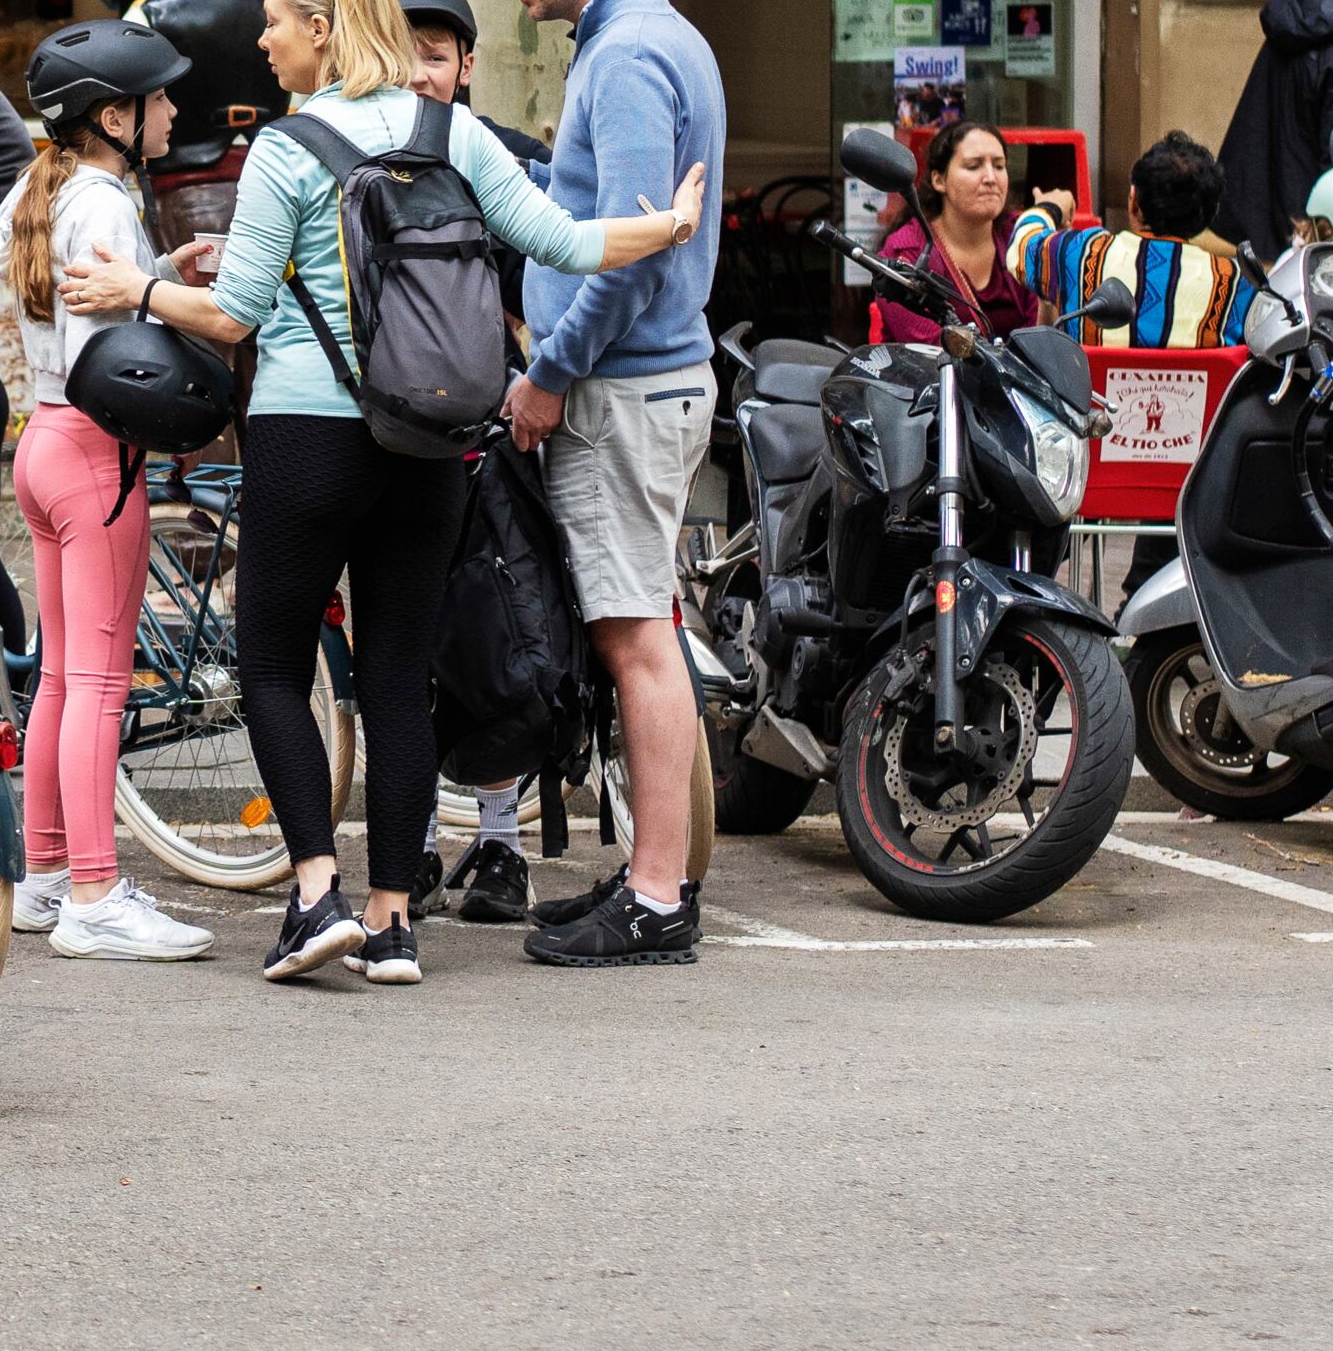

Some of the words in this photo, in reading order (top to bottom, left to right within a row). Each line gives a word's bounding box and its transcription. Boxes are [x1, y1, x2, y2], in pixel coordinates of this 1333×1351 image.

[905, 55, 959, 78] Swing!
[1109, 432, 1129, 448] EL
[1131, 437, 1158, 450] TIO
[1162, 433, 1194, 449] CHE
